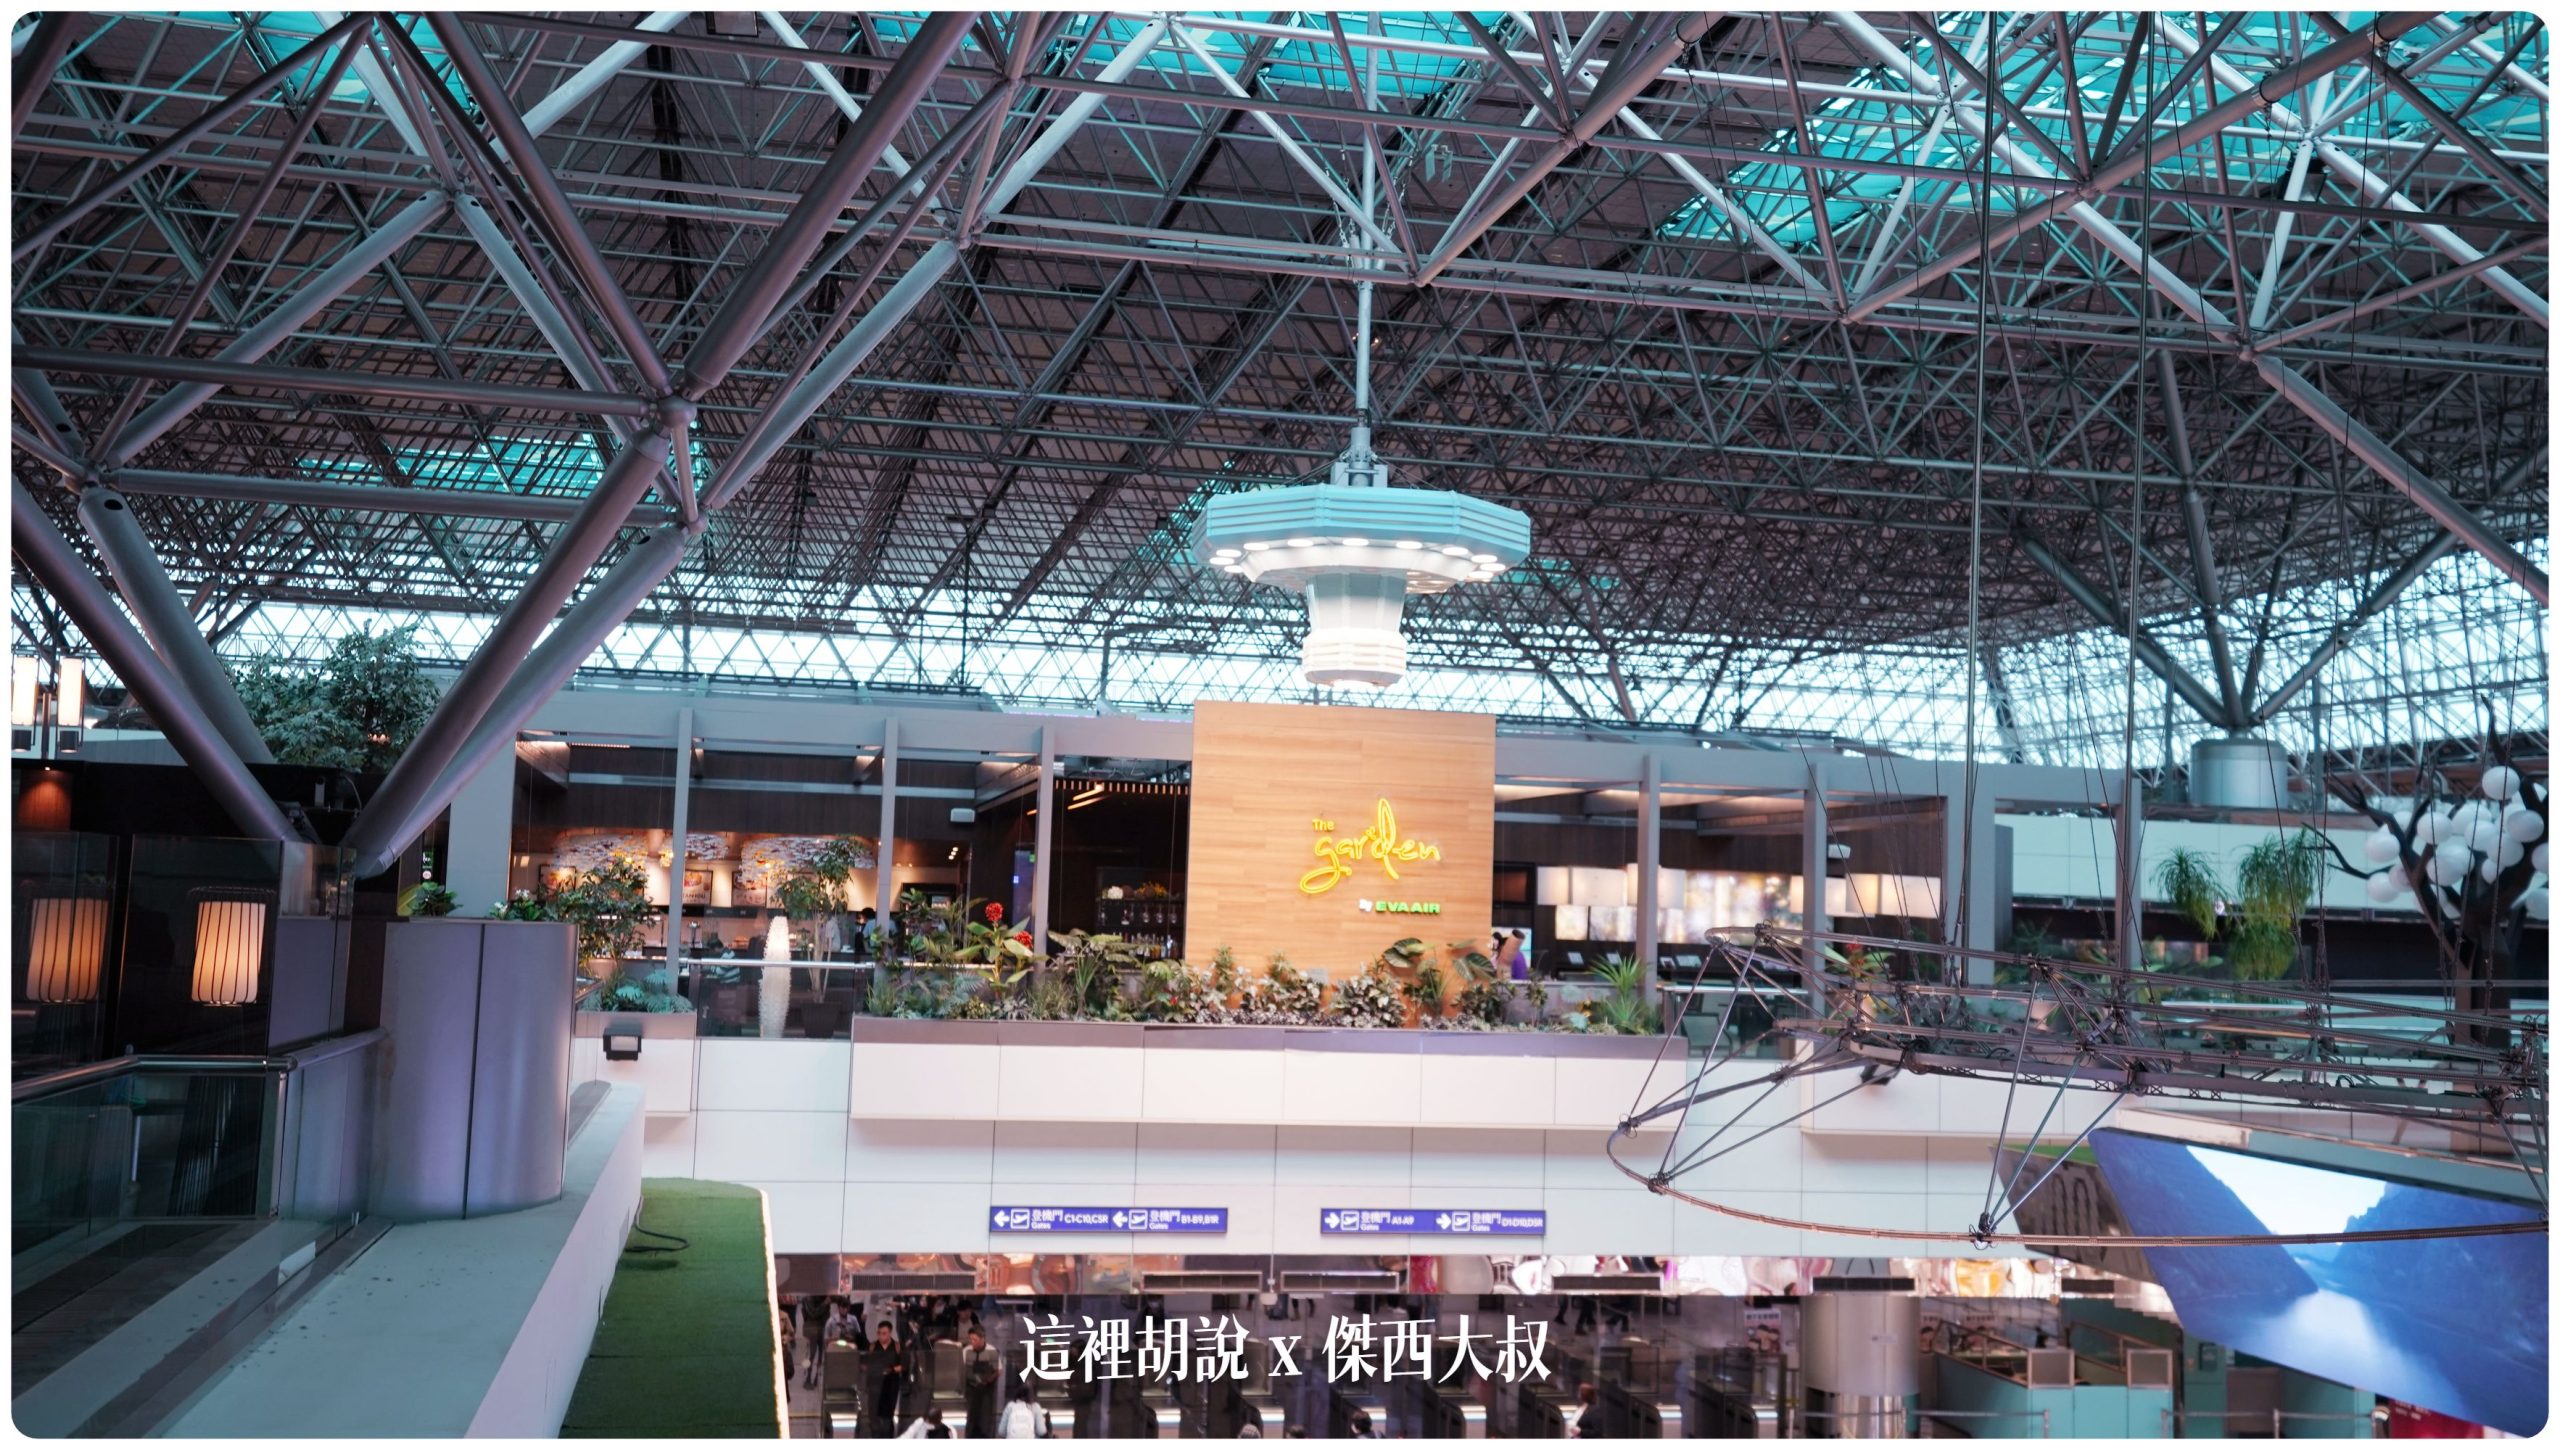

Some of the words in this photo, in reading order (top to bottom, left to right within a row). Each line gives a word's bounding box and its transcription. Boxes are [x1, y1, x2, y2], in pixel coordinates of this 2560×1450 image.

[1312, 819, 1335, 832] The
[1300, 798, 1441, 894] garden
[1031, 1209, 1064, 1222] 登機門
[1149, 1210, 1181, 1223] 登機門
[1360, 1211, 1391, 1224] 登機門
[1472, 1212, 1502, 1225] 登機門
[1031, 1221, 1051, 1230] Gates
[1149, 1222, 1169, 1231] Gates
